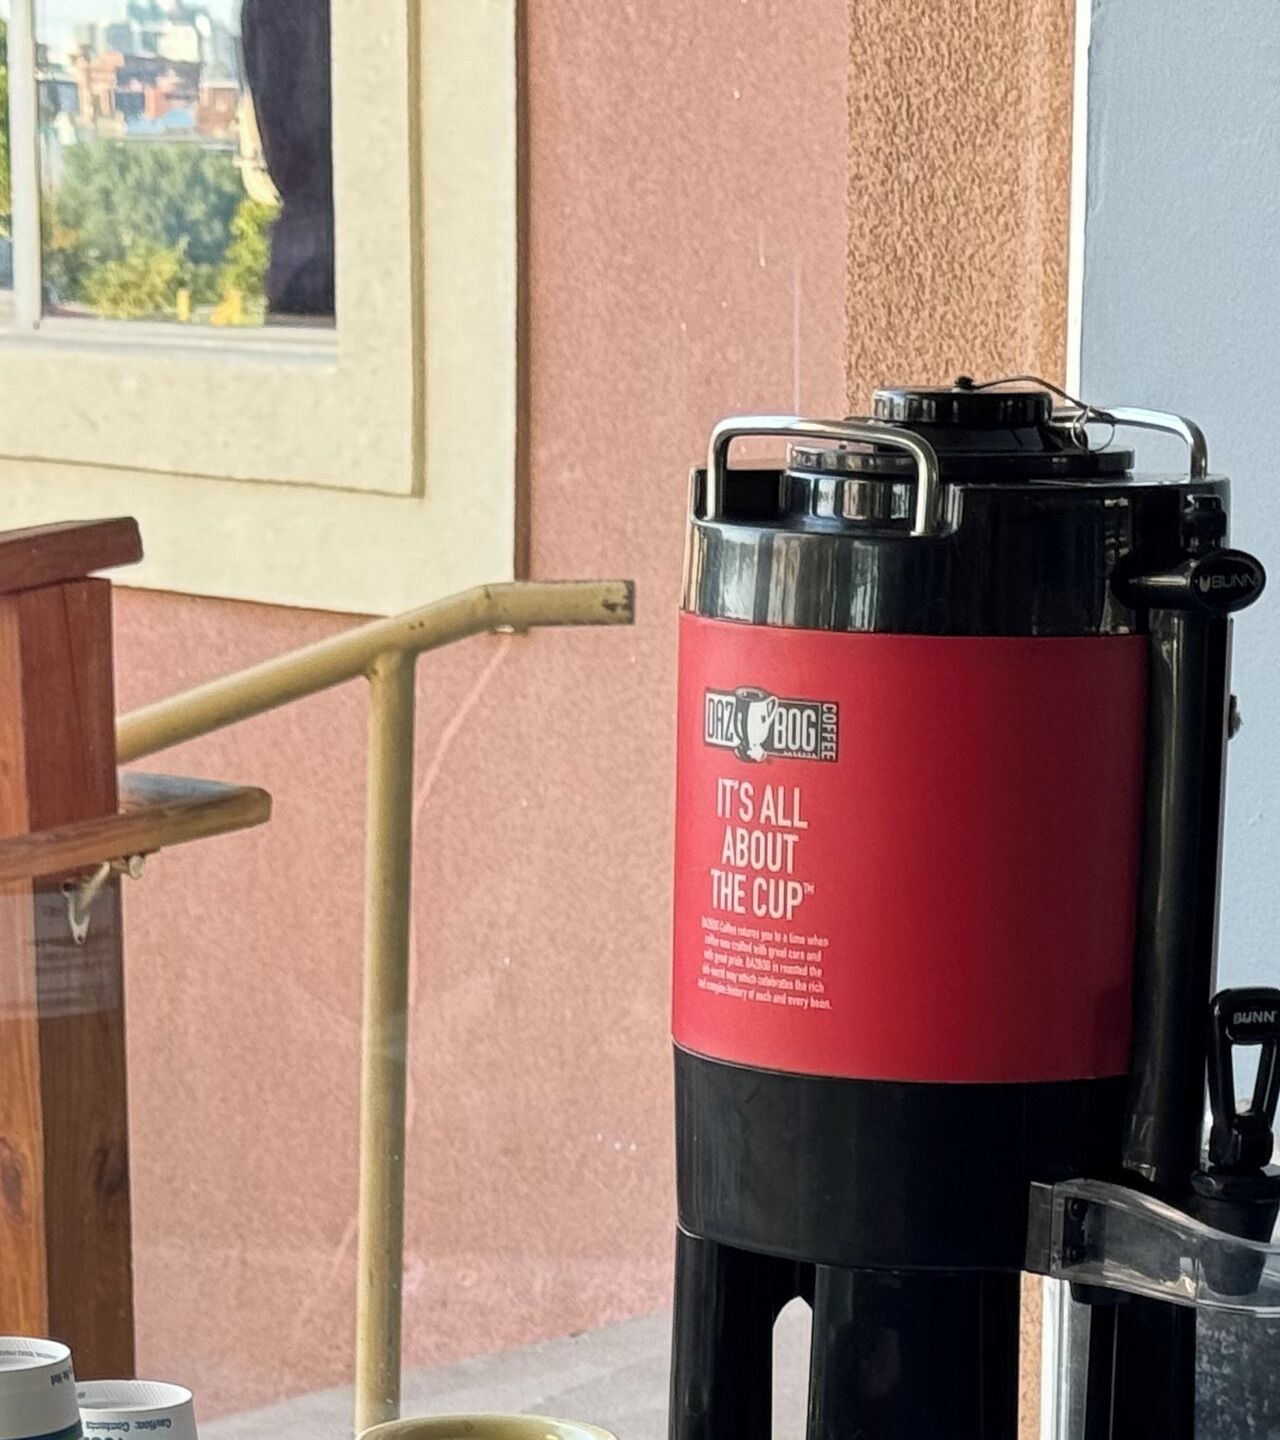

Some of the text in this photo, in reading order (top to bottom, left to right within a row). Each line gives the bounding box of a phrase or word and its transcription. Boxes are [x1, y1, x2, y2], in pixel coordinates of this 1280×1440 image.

[1211, 573, 1257, 589] BUNN
[821, 703, 838, 761] COFFEE
[717, 777, 809, 829] IT'S ALL
[721, 825, 800, 874] ABOUT
[710, 868, 747, 914] THE
[1233, 1010, 1277, 1025] BUNN
